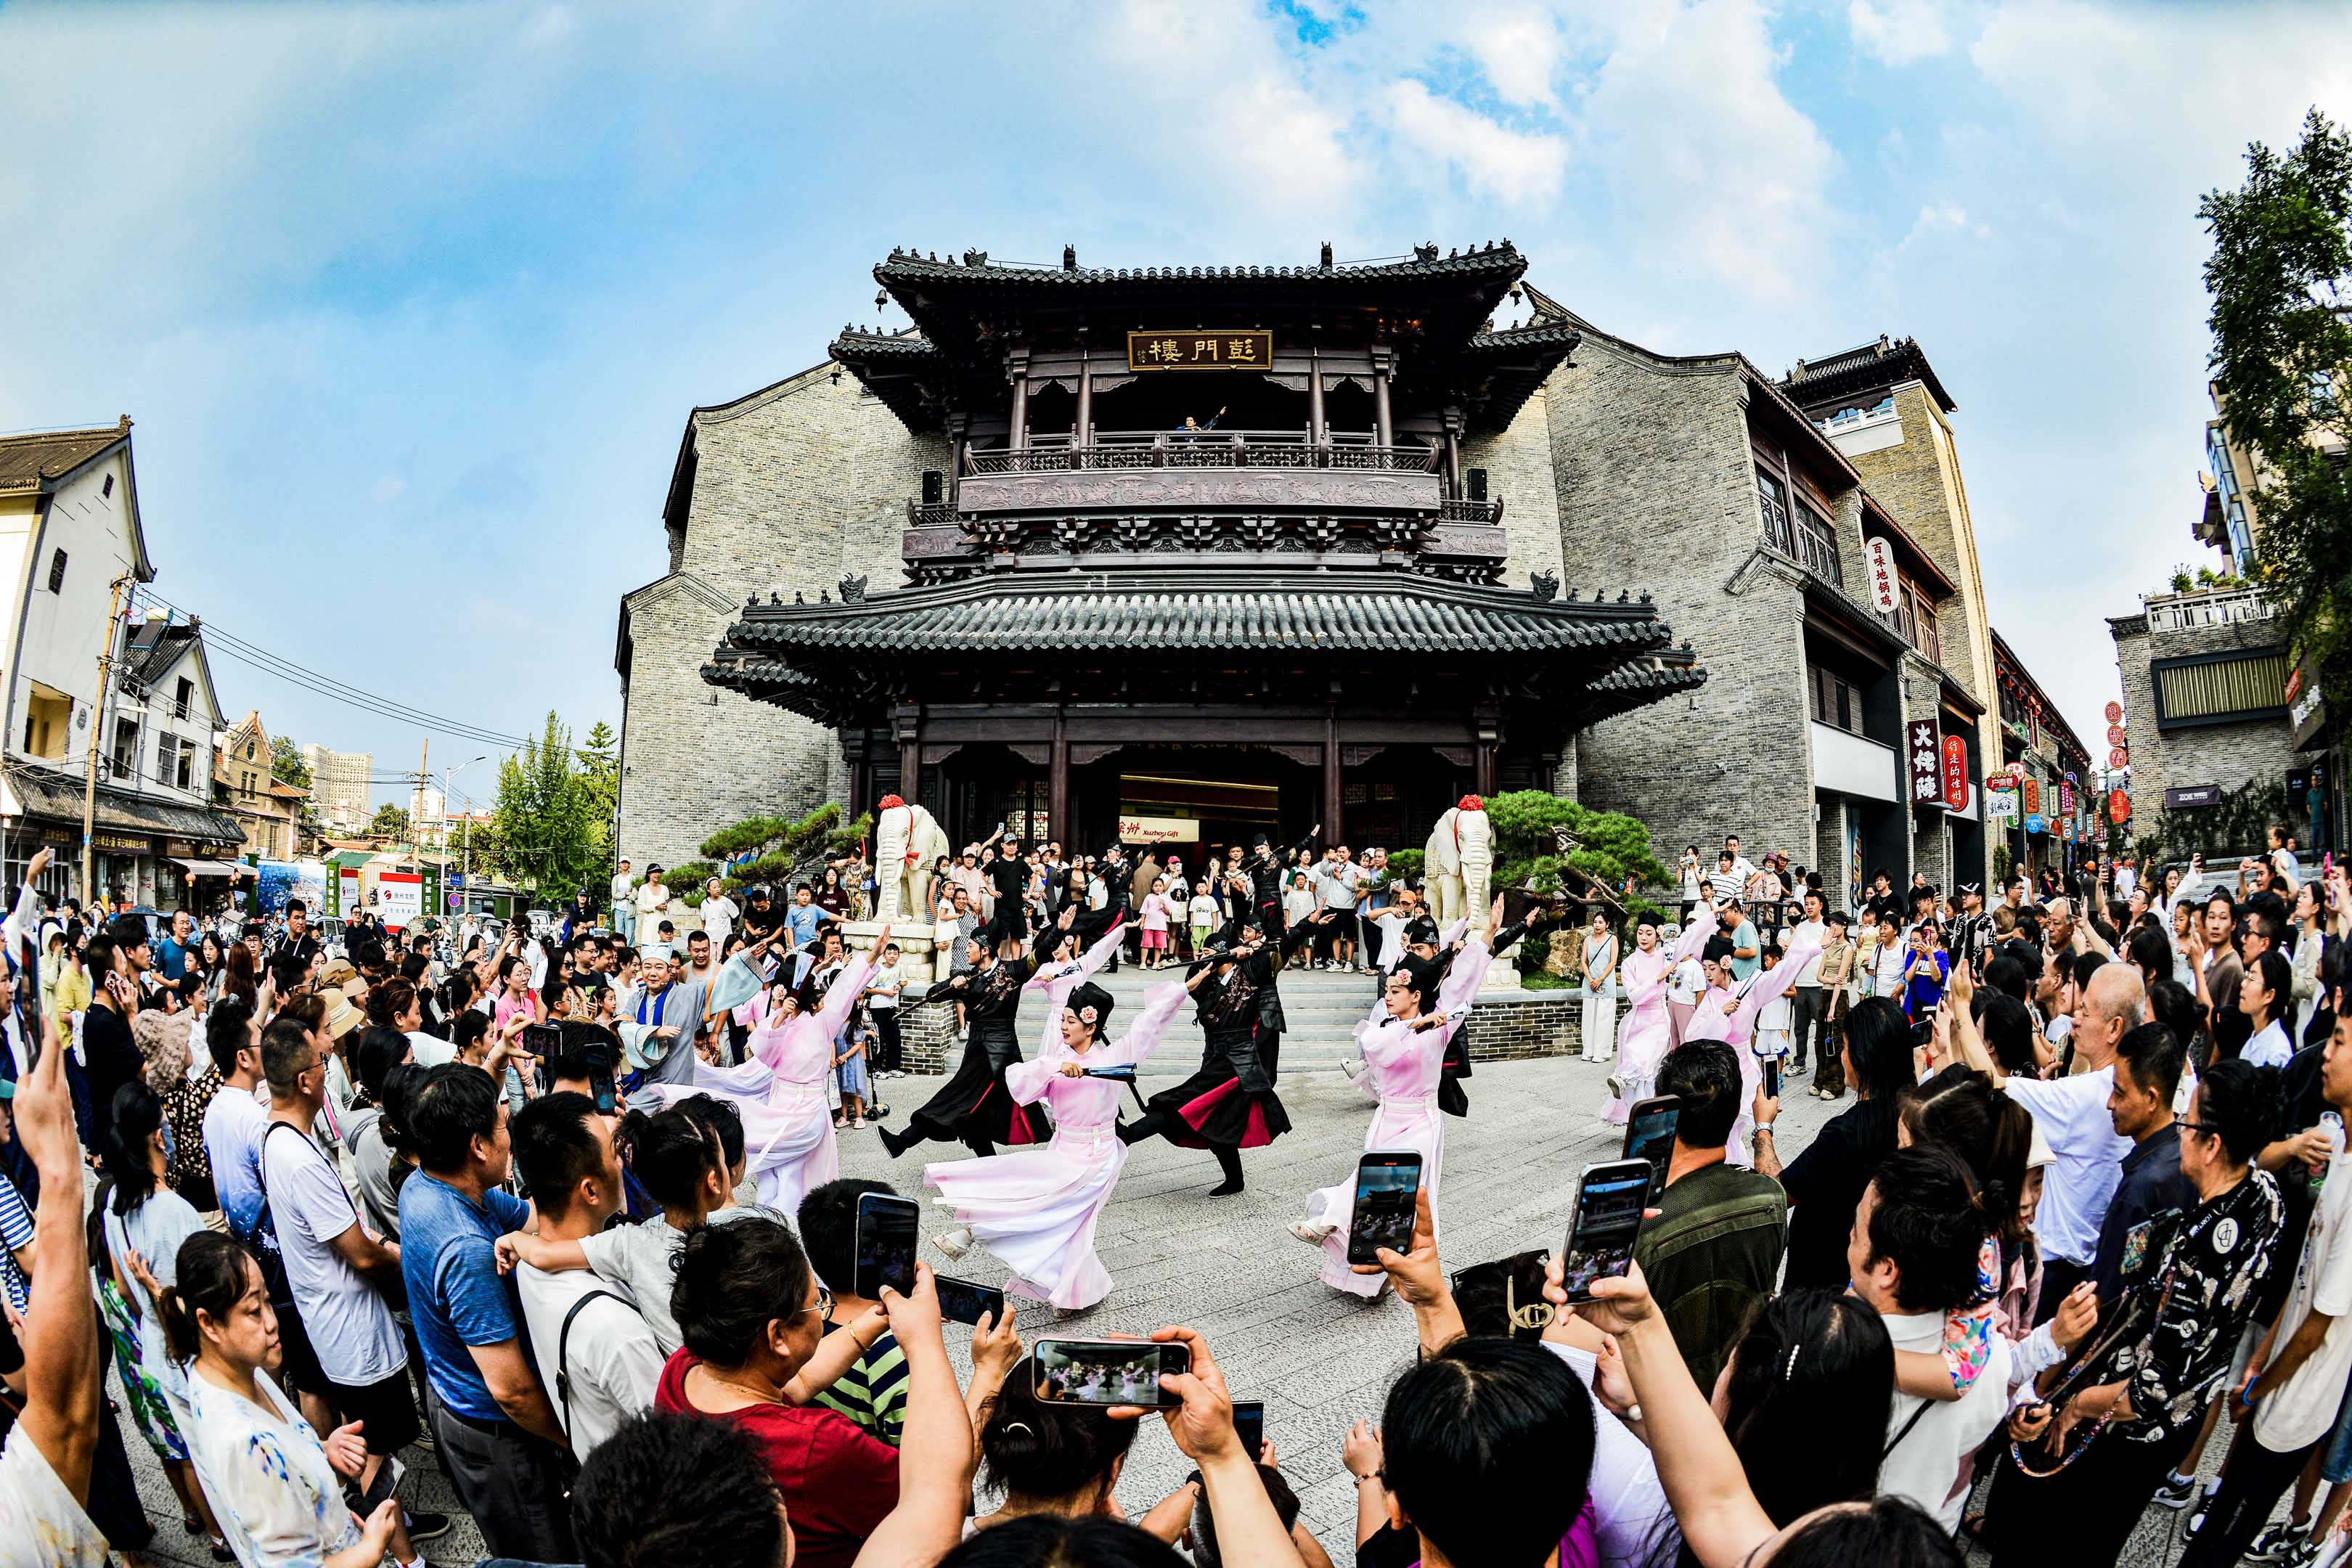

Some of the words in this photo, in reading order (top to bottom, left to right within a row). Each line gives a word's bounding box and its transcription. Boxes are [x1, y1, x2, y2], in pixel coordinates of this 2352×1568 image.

[1871, 542, 1892, 607] 百味地锅鸡
[1948, 740, 1961, 800] 行走的徐州
